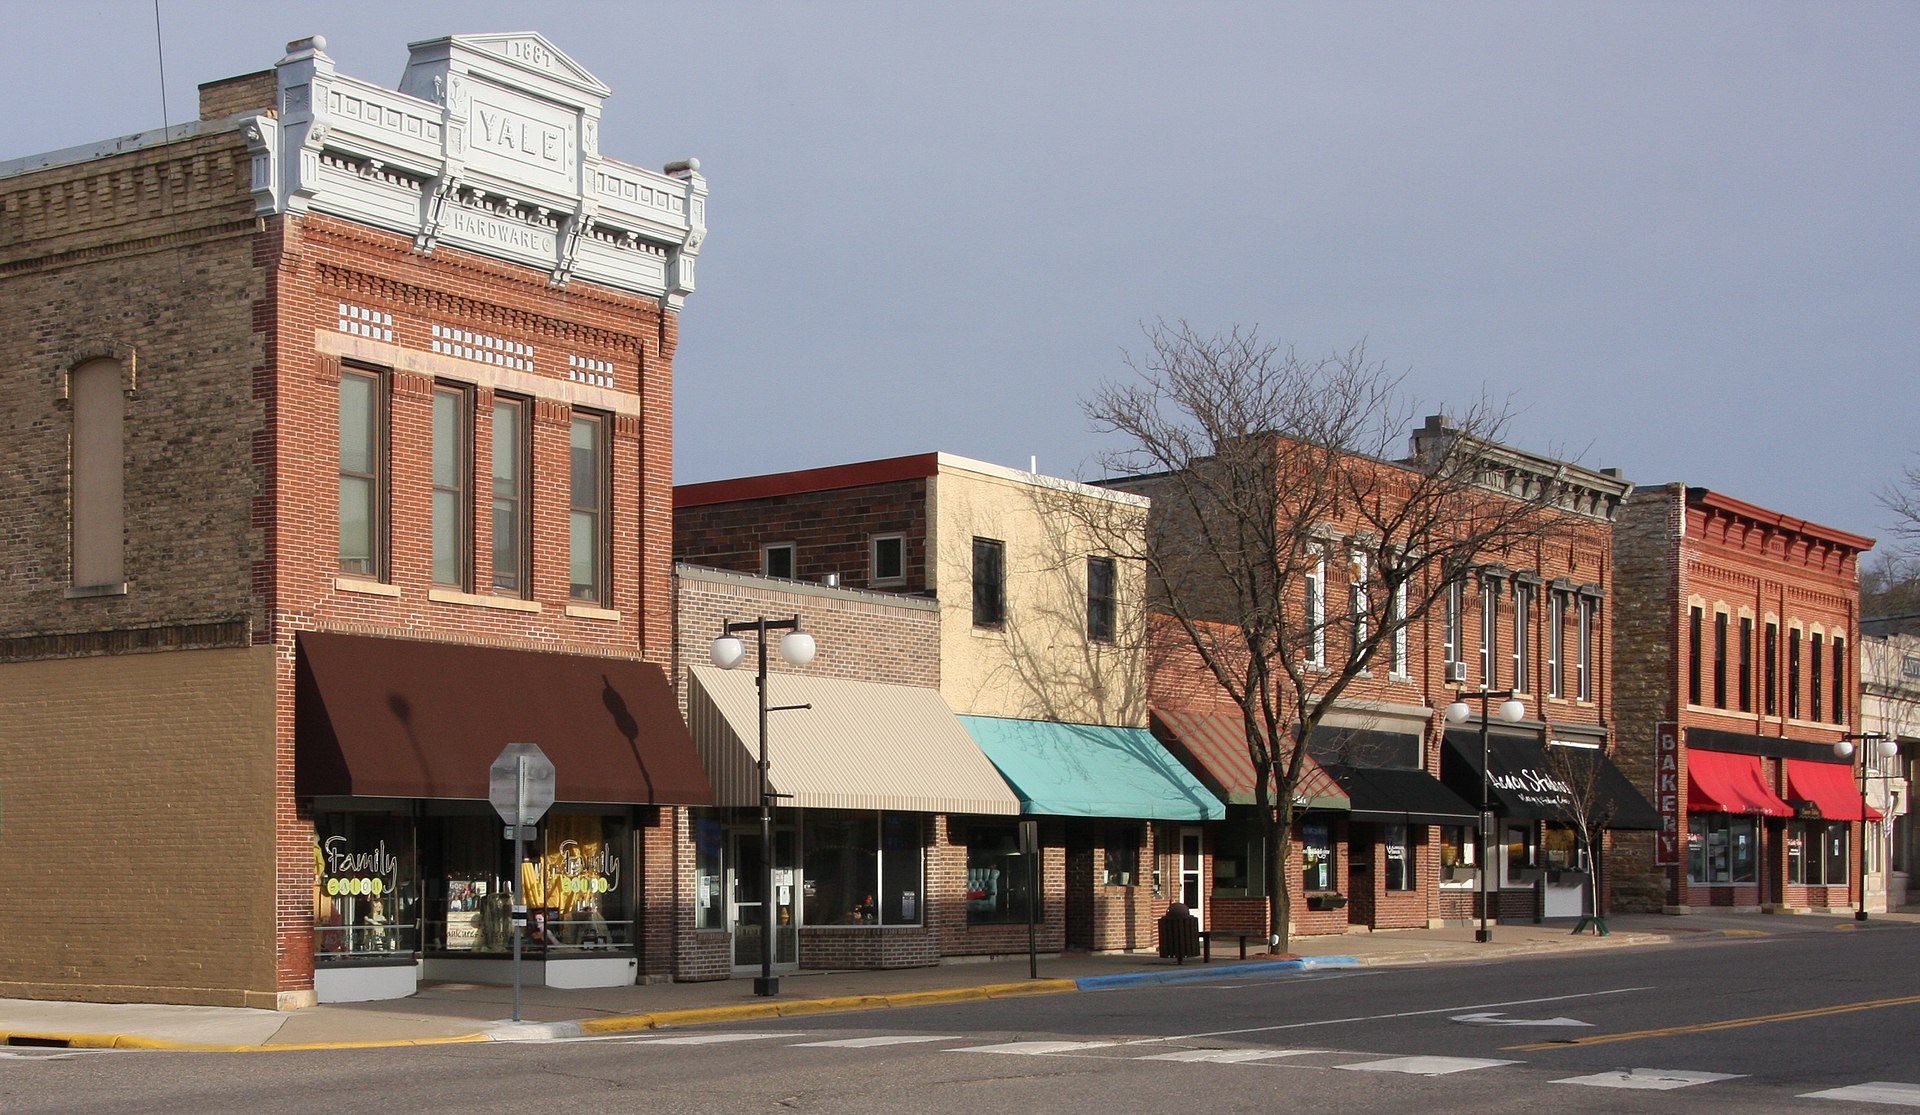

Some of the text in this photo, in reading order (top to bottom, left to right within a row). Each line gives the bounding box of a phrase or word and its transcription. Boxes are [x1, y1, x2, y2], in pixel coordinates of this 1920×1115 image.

[514, 41, 550, 67] 1887
[479, 109, 559, 162] YALE
[454, 212, 540, 251] HARDWARE
[1661, 733, 1677, 853] BAKERY
[324, 835, 398, 895] Family
[558, 839, 620, 893] Family
